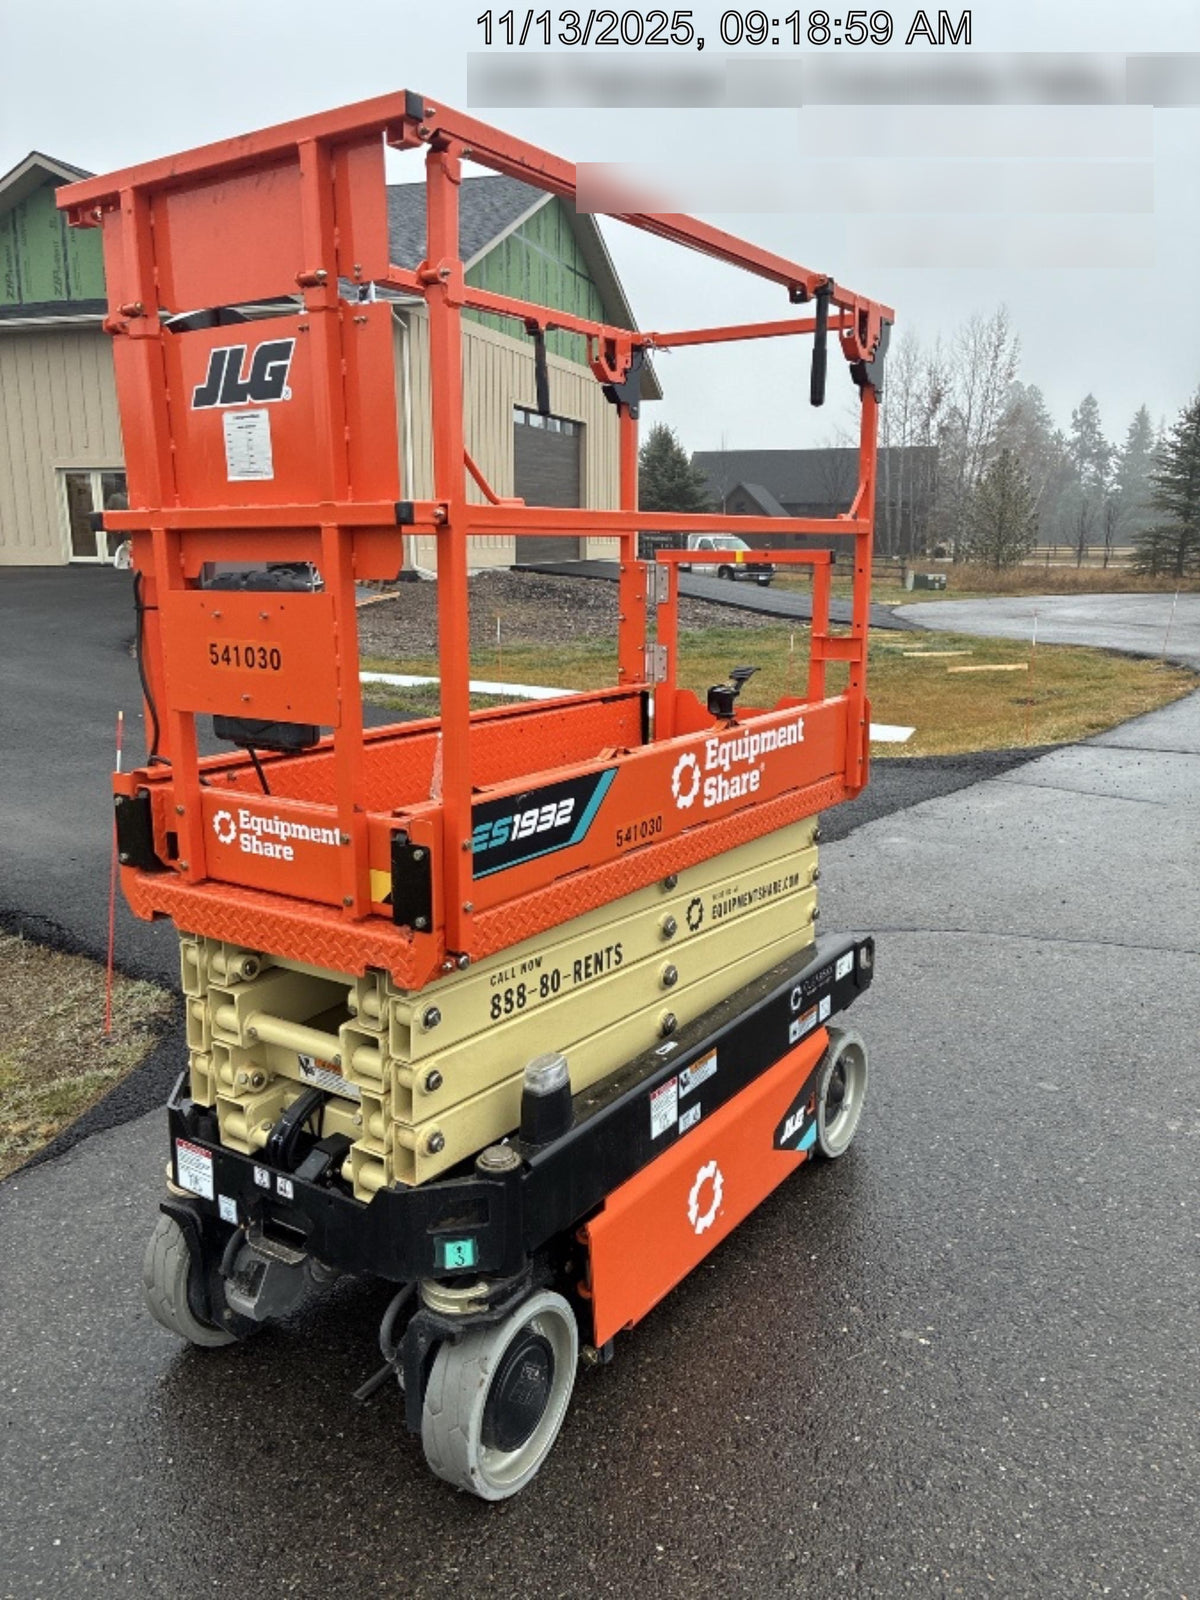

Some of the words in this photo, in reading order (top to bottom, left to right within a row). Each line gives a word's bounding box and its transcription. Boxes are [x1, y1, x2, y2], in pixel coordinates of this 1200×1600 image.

[191, 337, 295, 410] JLG
[209, 643, 281, 671] 541030
[704, 717, 805, 773] Equipment
[702, 767, 761, 808] Share
[238, 808, 341, 847] Equipment
[239, 832, 295, 861] Share
[473, 798, 576, 854] ES1932
[616, 815, 663, 848] 541030
[489, 966, 516, 988] CALL
[520, 956, 543, 975] NOW
[490, 941, 623, 1020] 888-80-RENTS
[779, 1104, 806, 1146] JLG
